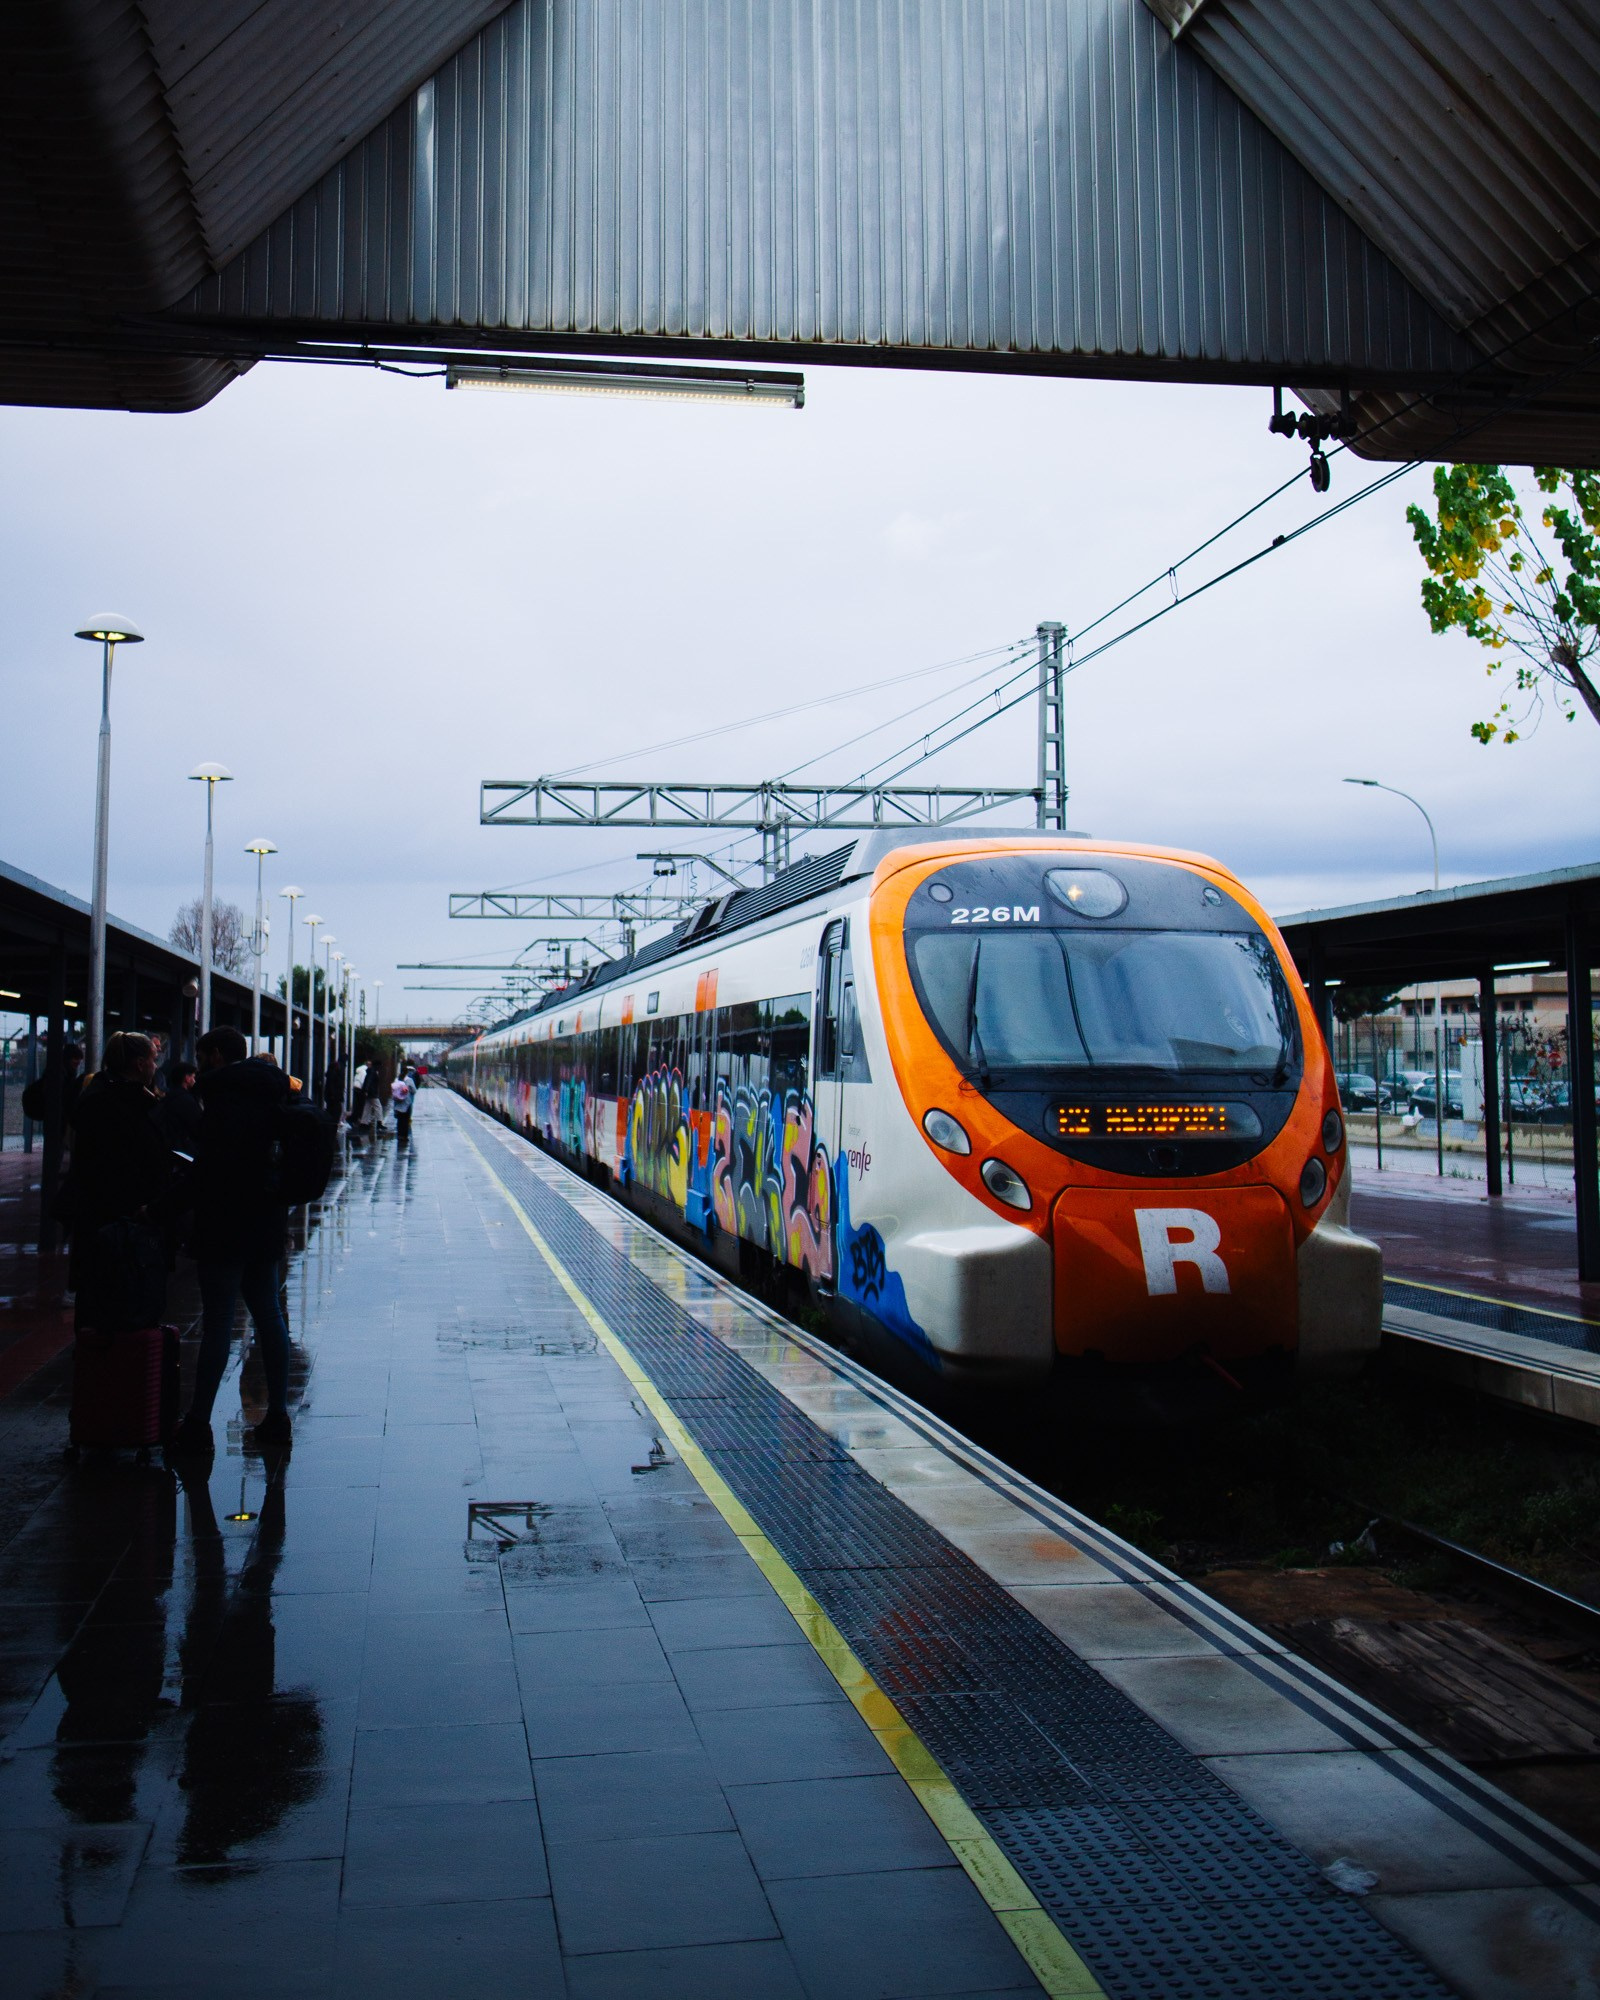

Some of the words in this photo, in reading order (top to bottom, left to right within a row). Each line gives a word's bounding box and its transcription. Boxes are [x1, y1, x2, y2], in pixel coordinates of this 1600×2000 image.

[951, 906, 1040, 924] 226M
[847, 1141, 872, 1181] renfe
[1134, 1207, 1231, 1296] R
